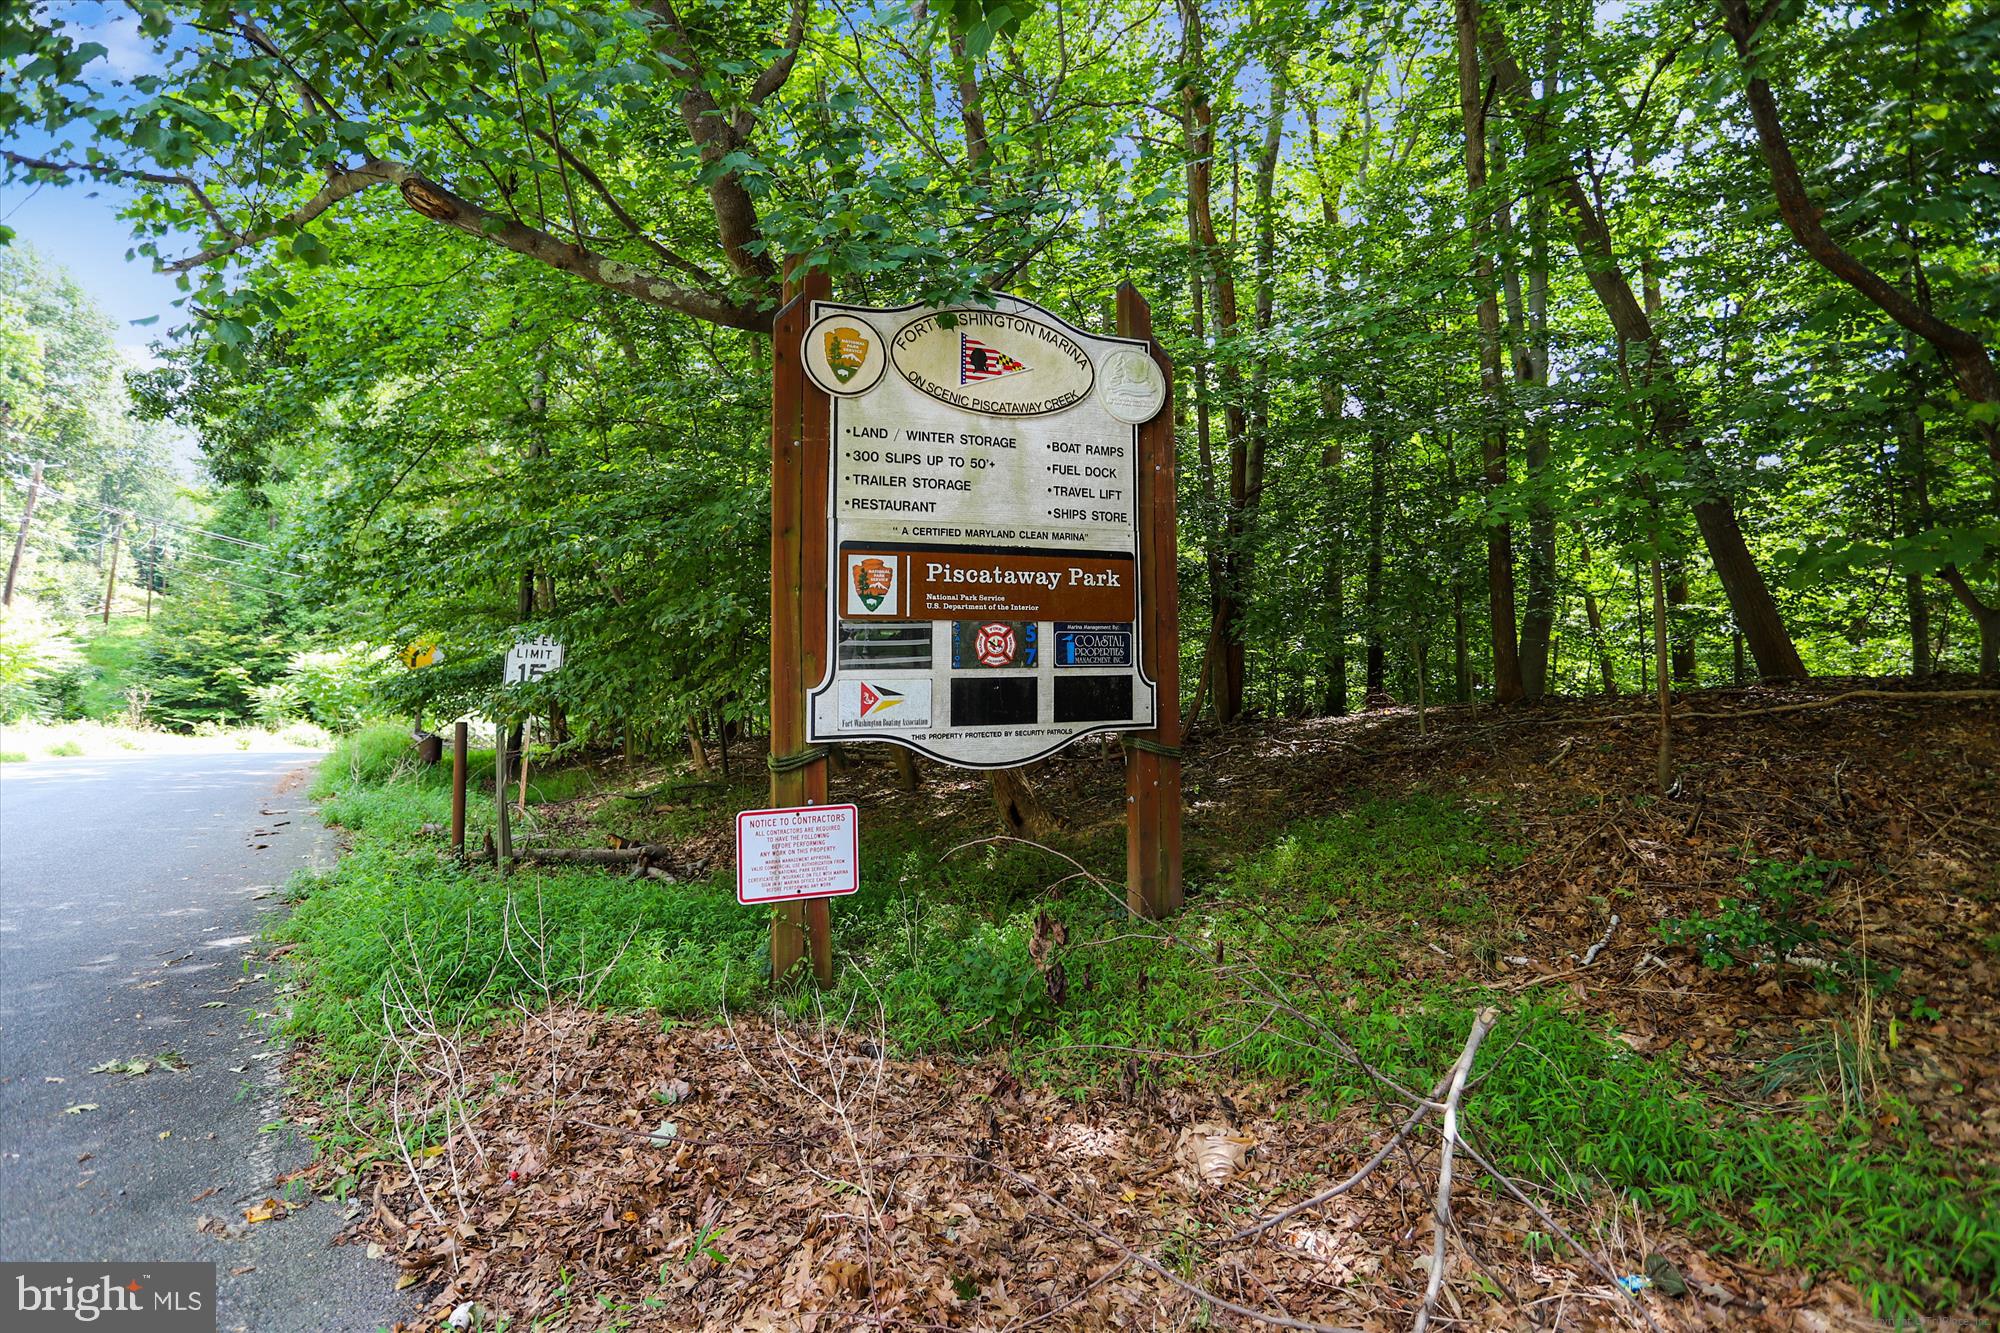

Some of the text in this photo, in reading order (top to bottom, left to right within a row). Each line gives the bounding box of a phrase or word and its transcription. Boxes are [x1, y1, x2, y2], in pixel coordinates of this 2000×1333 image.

[896, 313, 1087, 370] FORT SHINGTON MARINA
[908, 371, 1079, 413] ON SCENIC PISCATAWAY CREEK
[853, 427, 888, 439] LAND
[906, 430, 954, 443] WINTER
[960, 434, 1016, 448] STORAGE
[1052, 442, 1124, 457] BOAT RAMPS
[853, 451, 879, 462] 300
[885, 452, 921, 465] SLIPS
[927, 456, 943, 466] UP
[949, 457, 964, 467] TO
[1052, 464, 1117, 478] FUEL DOCK
[853, 474, 971, 491] TRAILER STORAGE
[1053, 486, 1122, 500] TRAVEL LIFT
[852, 498, 936, 512] RESTAURANT
[1053, 508, 1127, 522] SHIPS STORE
[912, 527, 961, 537] CERTIFIED
[965, 529, 1015, 539] MARYLAND
[1018, 530, 1048, 540] CLEAN
[926, 563, 1120, 590] Piscataway Park
[943, 603, 987, 611] Department
[515, 637, 559, 647] EED
[1075, 635, 1124, 647] COASTAL
[517, 649, 552, 659] LIMIT
[1075, 648, 1124, 656] PROPERTIES
[518, 664, 546, 682] 15
[842, 718, 928, 728] Fort Washington Boating Association
[750, 819, 776, 828] NOTICE
[792, 814, 846, 825] CONTRACTORS
[767, 828, 803, 836] CONTRACTORS
